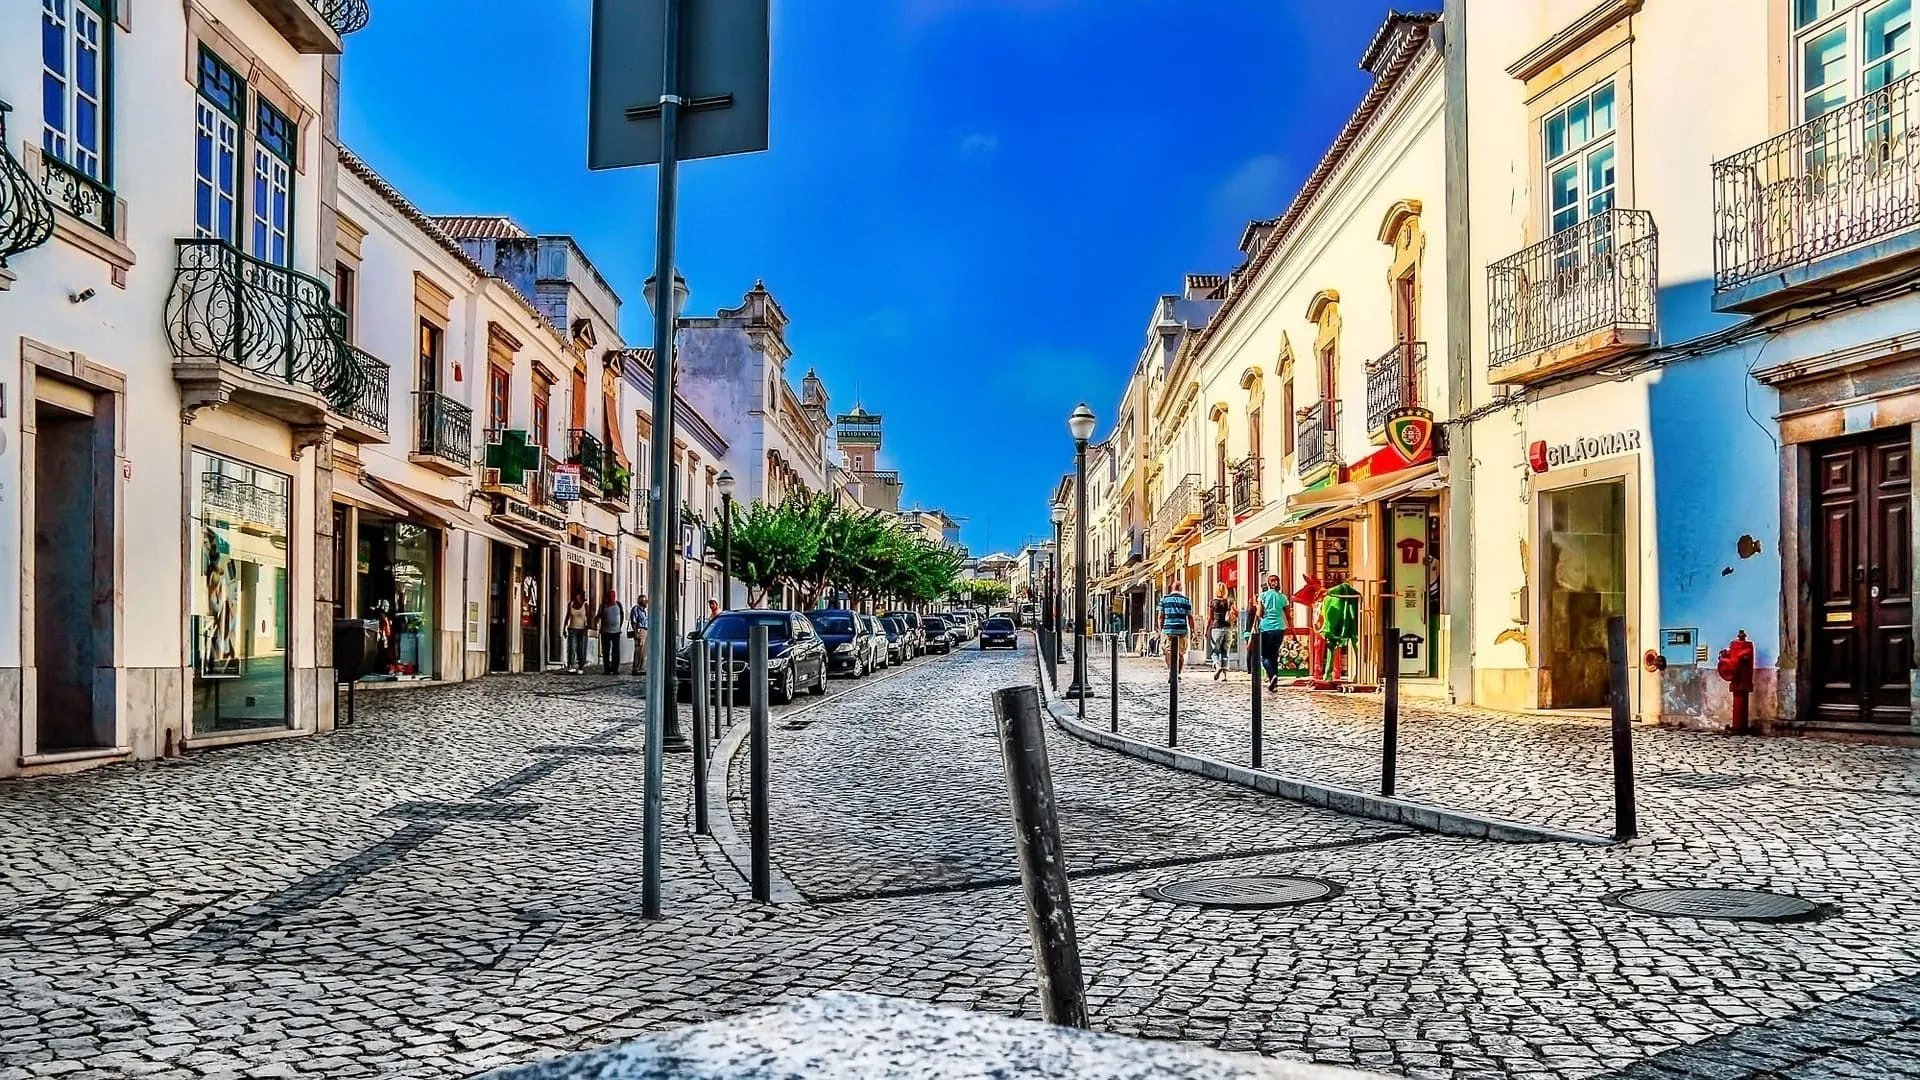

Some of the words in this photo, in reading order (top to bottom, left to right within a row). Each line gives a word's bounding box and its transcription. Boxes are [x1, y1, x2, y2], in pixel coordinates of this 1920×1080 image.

[685, 528, 692, 547] P
[1407, 546, 1414, 560] 7
[1406, 642, 1414, 655] 9
